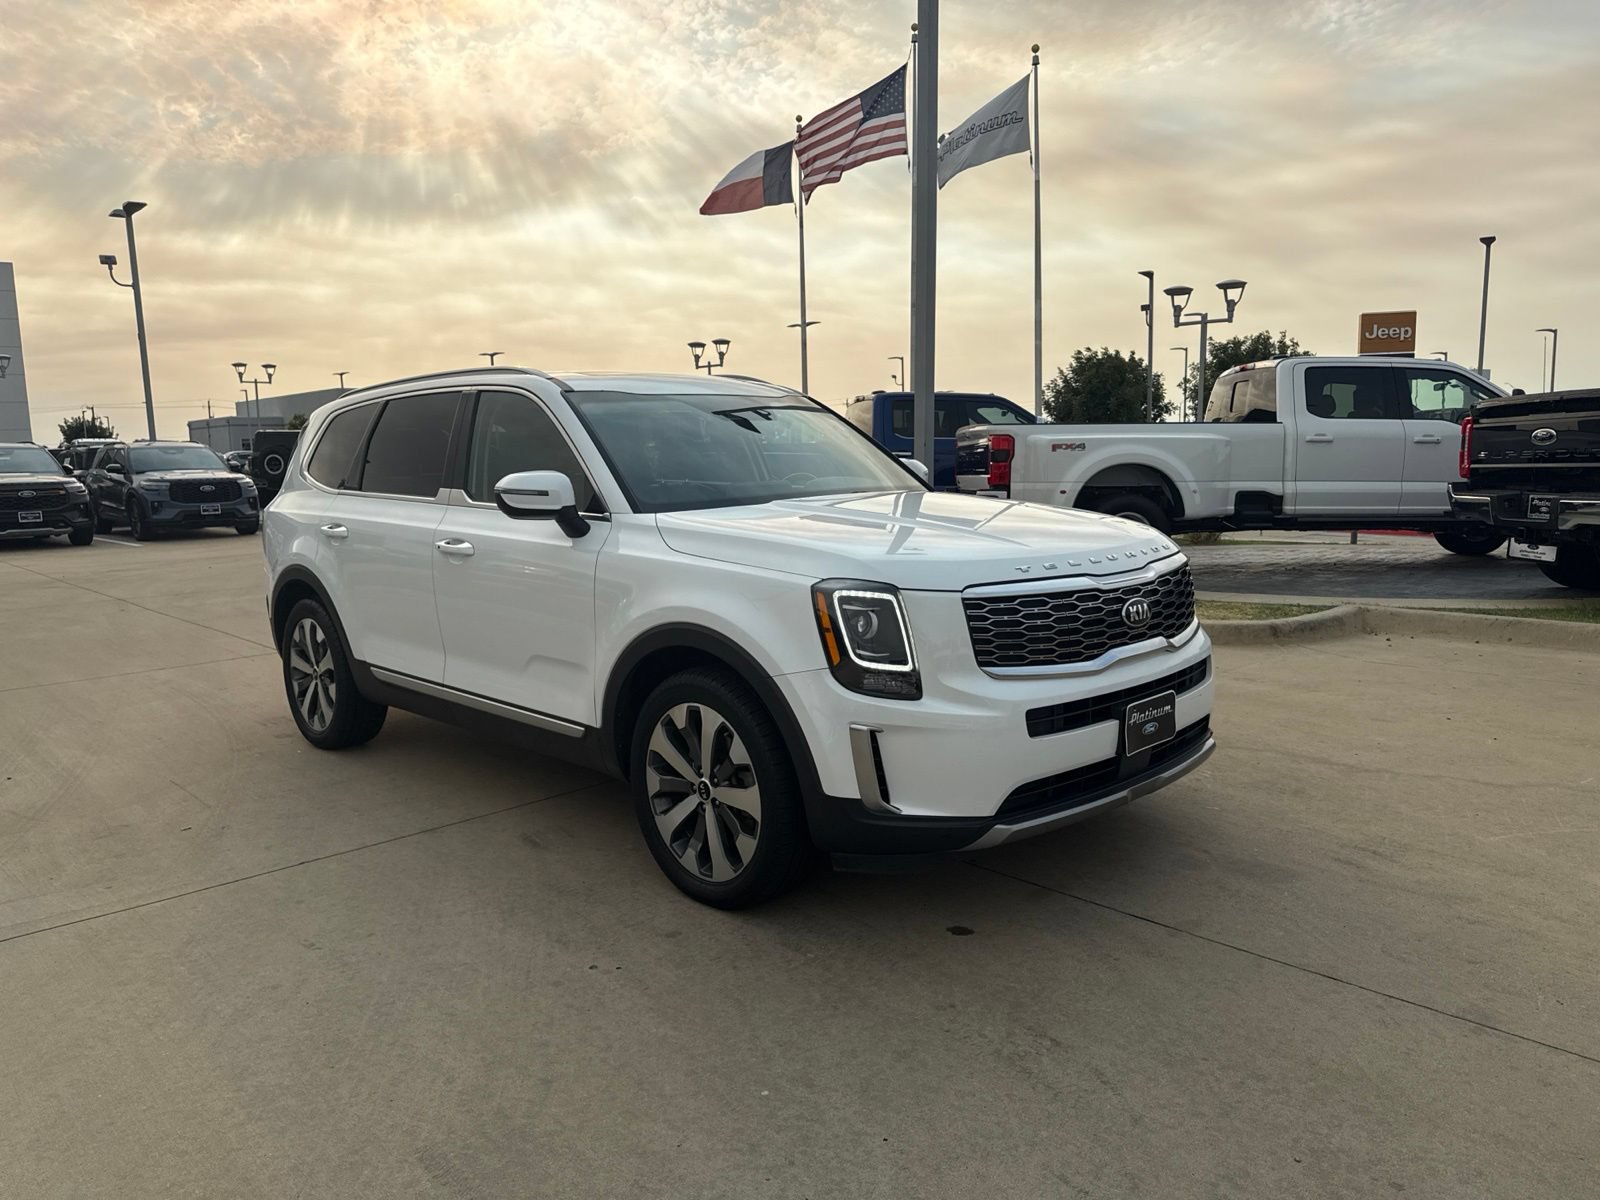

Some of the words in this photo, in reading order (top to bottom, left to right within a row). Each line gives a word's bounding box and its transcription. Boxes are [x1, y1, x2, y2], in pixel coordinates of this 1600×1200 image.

[937, 111, 1024, 161] Platinum
[1365, 323, 1412, 341] Jeep
[1015, 543, 1171, 573] TELLURIDE
[1128, 602, 1150, 622] KIA
[1128, 705, 1173, 727] Platinum
